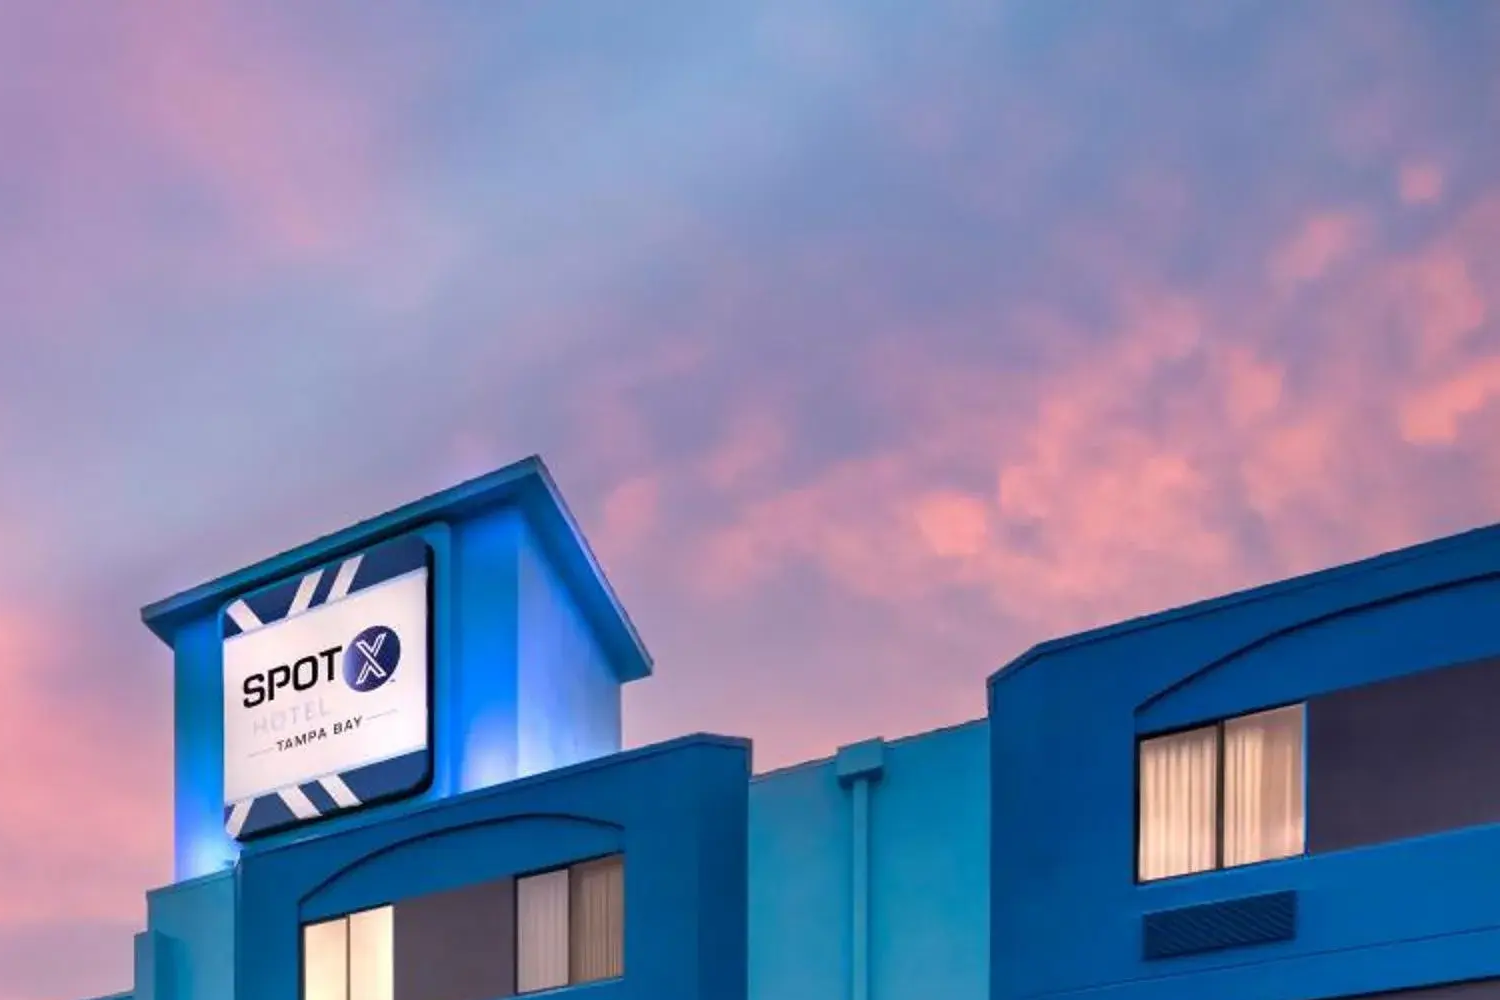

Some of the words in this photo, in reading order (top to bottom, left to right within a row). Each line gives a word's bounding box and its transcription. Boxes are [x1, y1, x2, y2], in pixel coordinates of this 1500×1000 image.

[243, 645, 343, 709] SPOT
[356, 632, 388, 686] X
[253, 697, 330, 735] HOTEL
[277, 728, 327, 751] TAMPA
[333, 716, 363, 735] BAY
